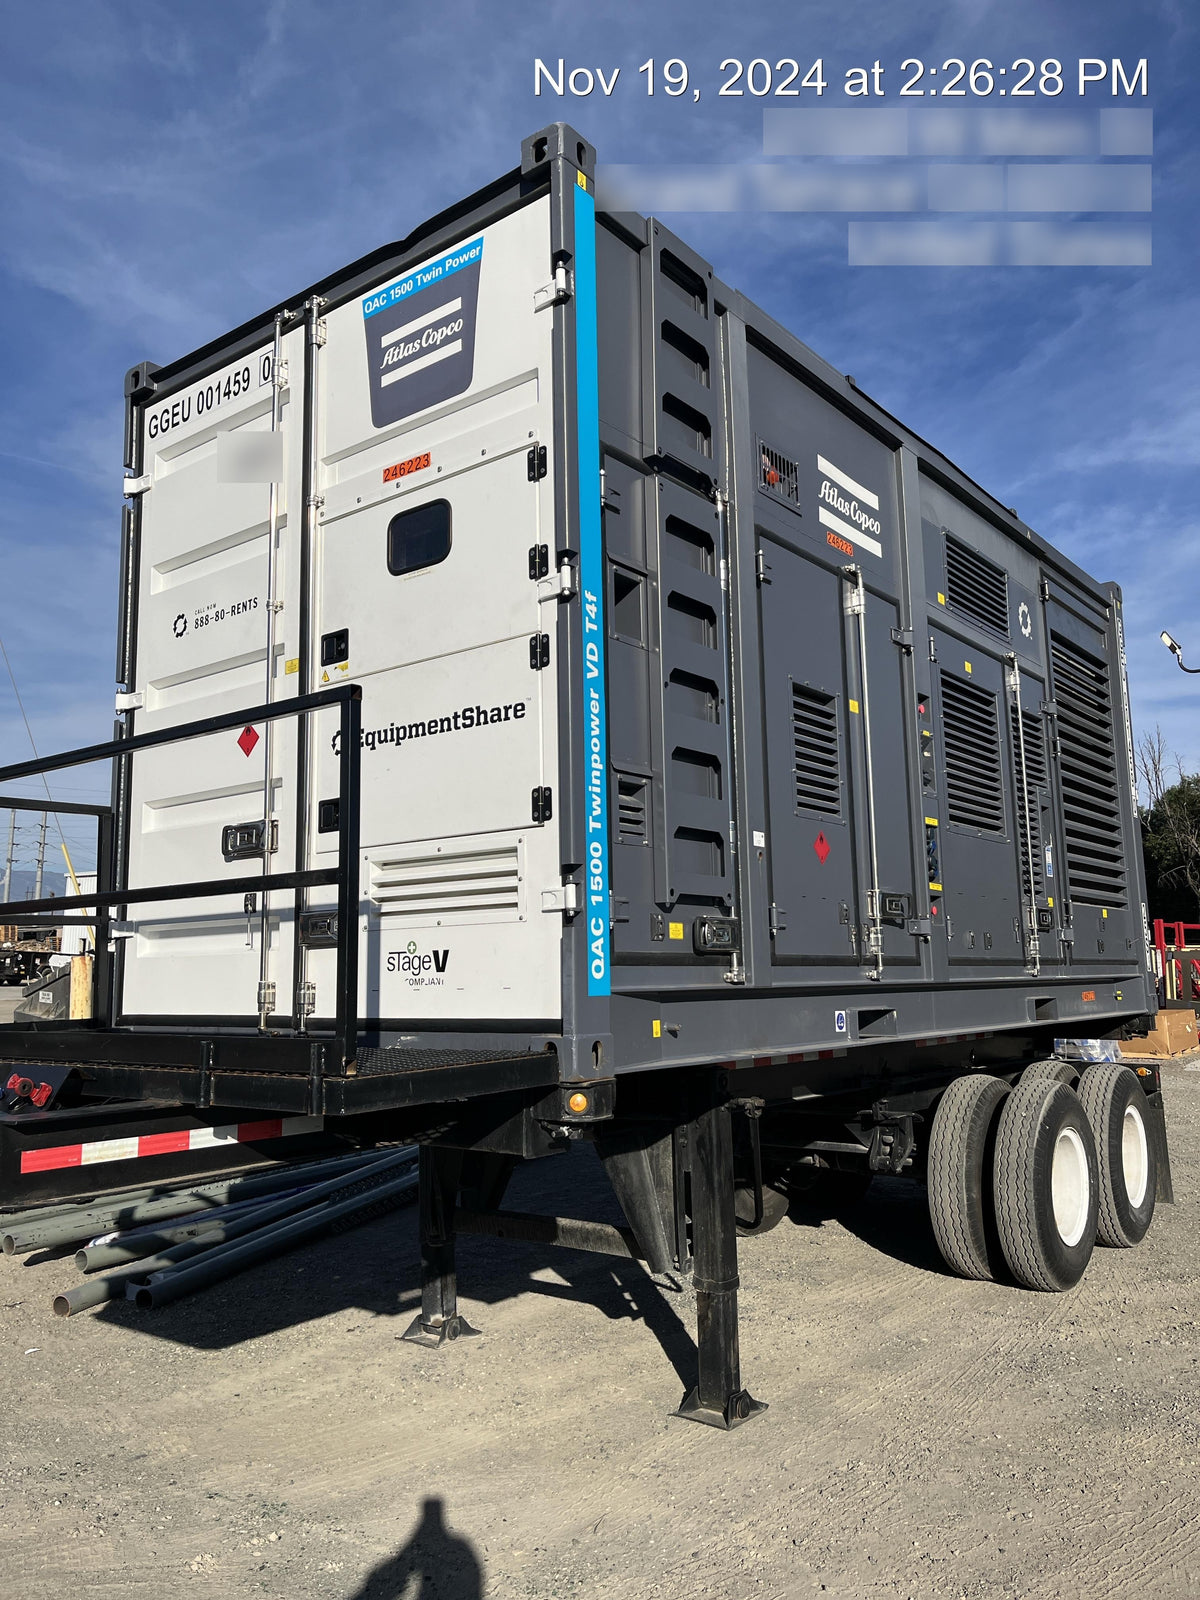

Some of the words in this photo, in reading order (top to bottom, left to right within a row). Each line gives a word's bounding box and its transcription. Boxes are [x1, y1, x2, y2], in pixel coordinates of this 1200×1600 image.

[364, 293, 387, 314] QAC
[389, 279, 413, 301] 1500
[415, 266, 442, 288] Twin
[445, 245, 481, 271] Power
[148, 396, 191, 439] GGEU
[197, 366, 250, 415] 001459
[262, 355, 271, 381] 0
[383, 453, 430, 482] 246223
[194, 597, 258, 629] 888-80-RENTS
[585, 590, 598, 633] T4f
[586, 642, 599, 679] VD
[588, 688, 604, 833] Twinpower
[589, 841, 604, 907] 1500
[591, 917, 605, 980] QAC
